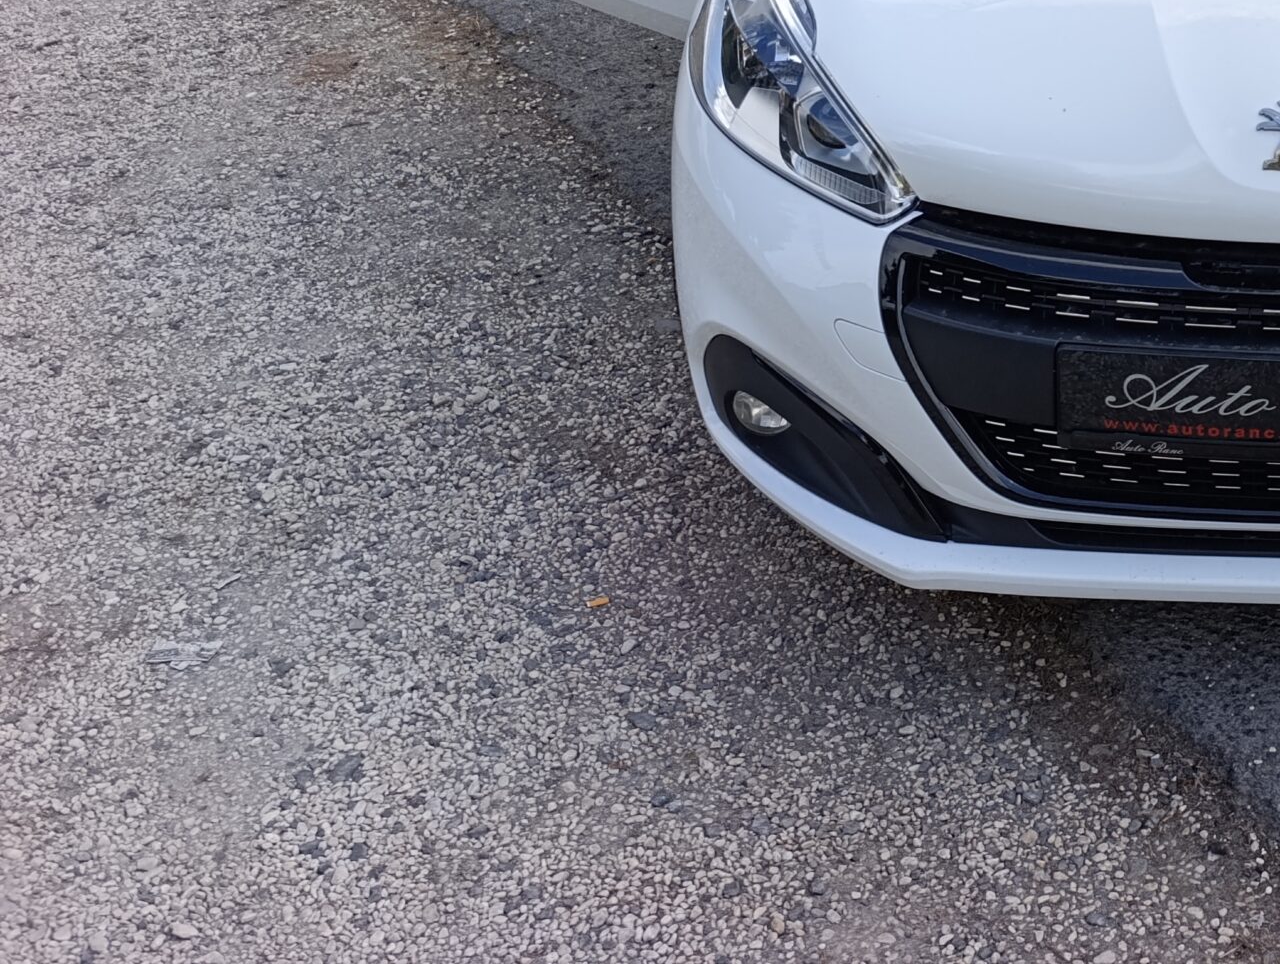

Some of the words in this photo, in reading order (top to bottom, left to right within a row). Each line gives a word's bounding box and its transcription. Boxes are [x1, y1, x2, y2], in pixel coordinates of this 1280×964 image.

[1105, 364, 1277, 417] Auto
[1112, 439, 1145, 452] Auto
[1147, 441, 1184, 455] Ranc
